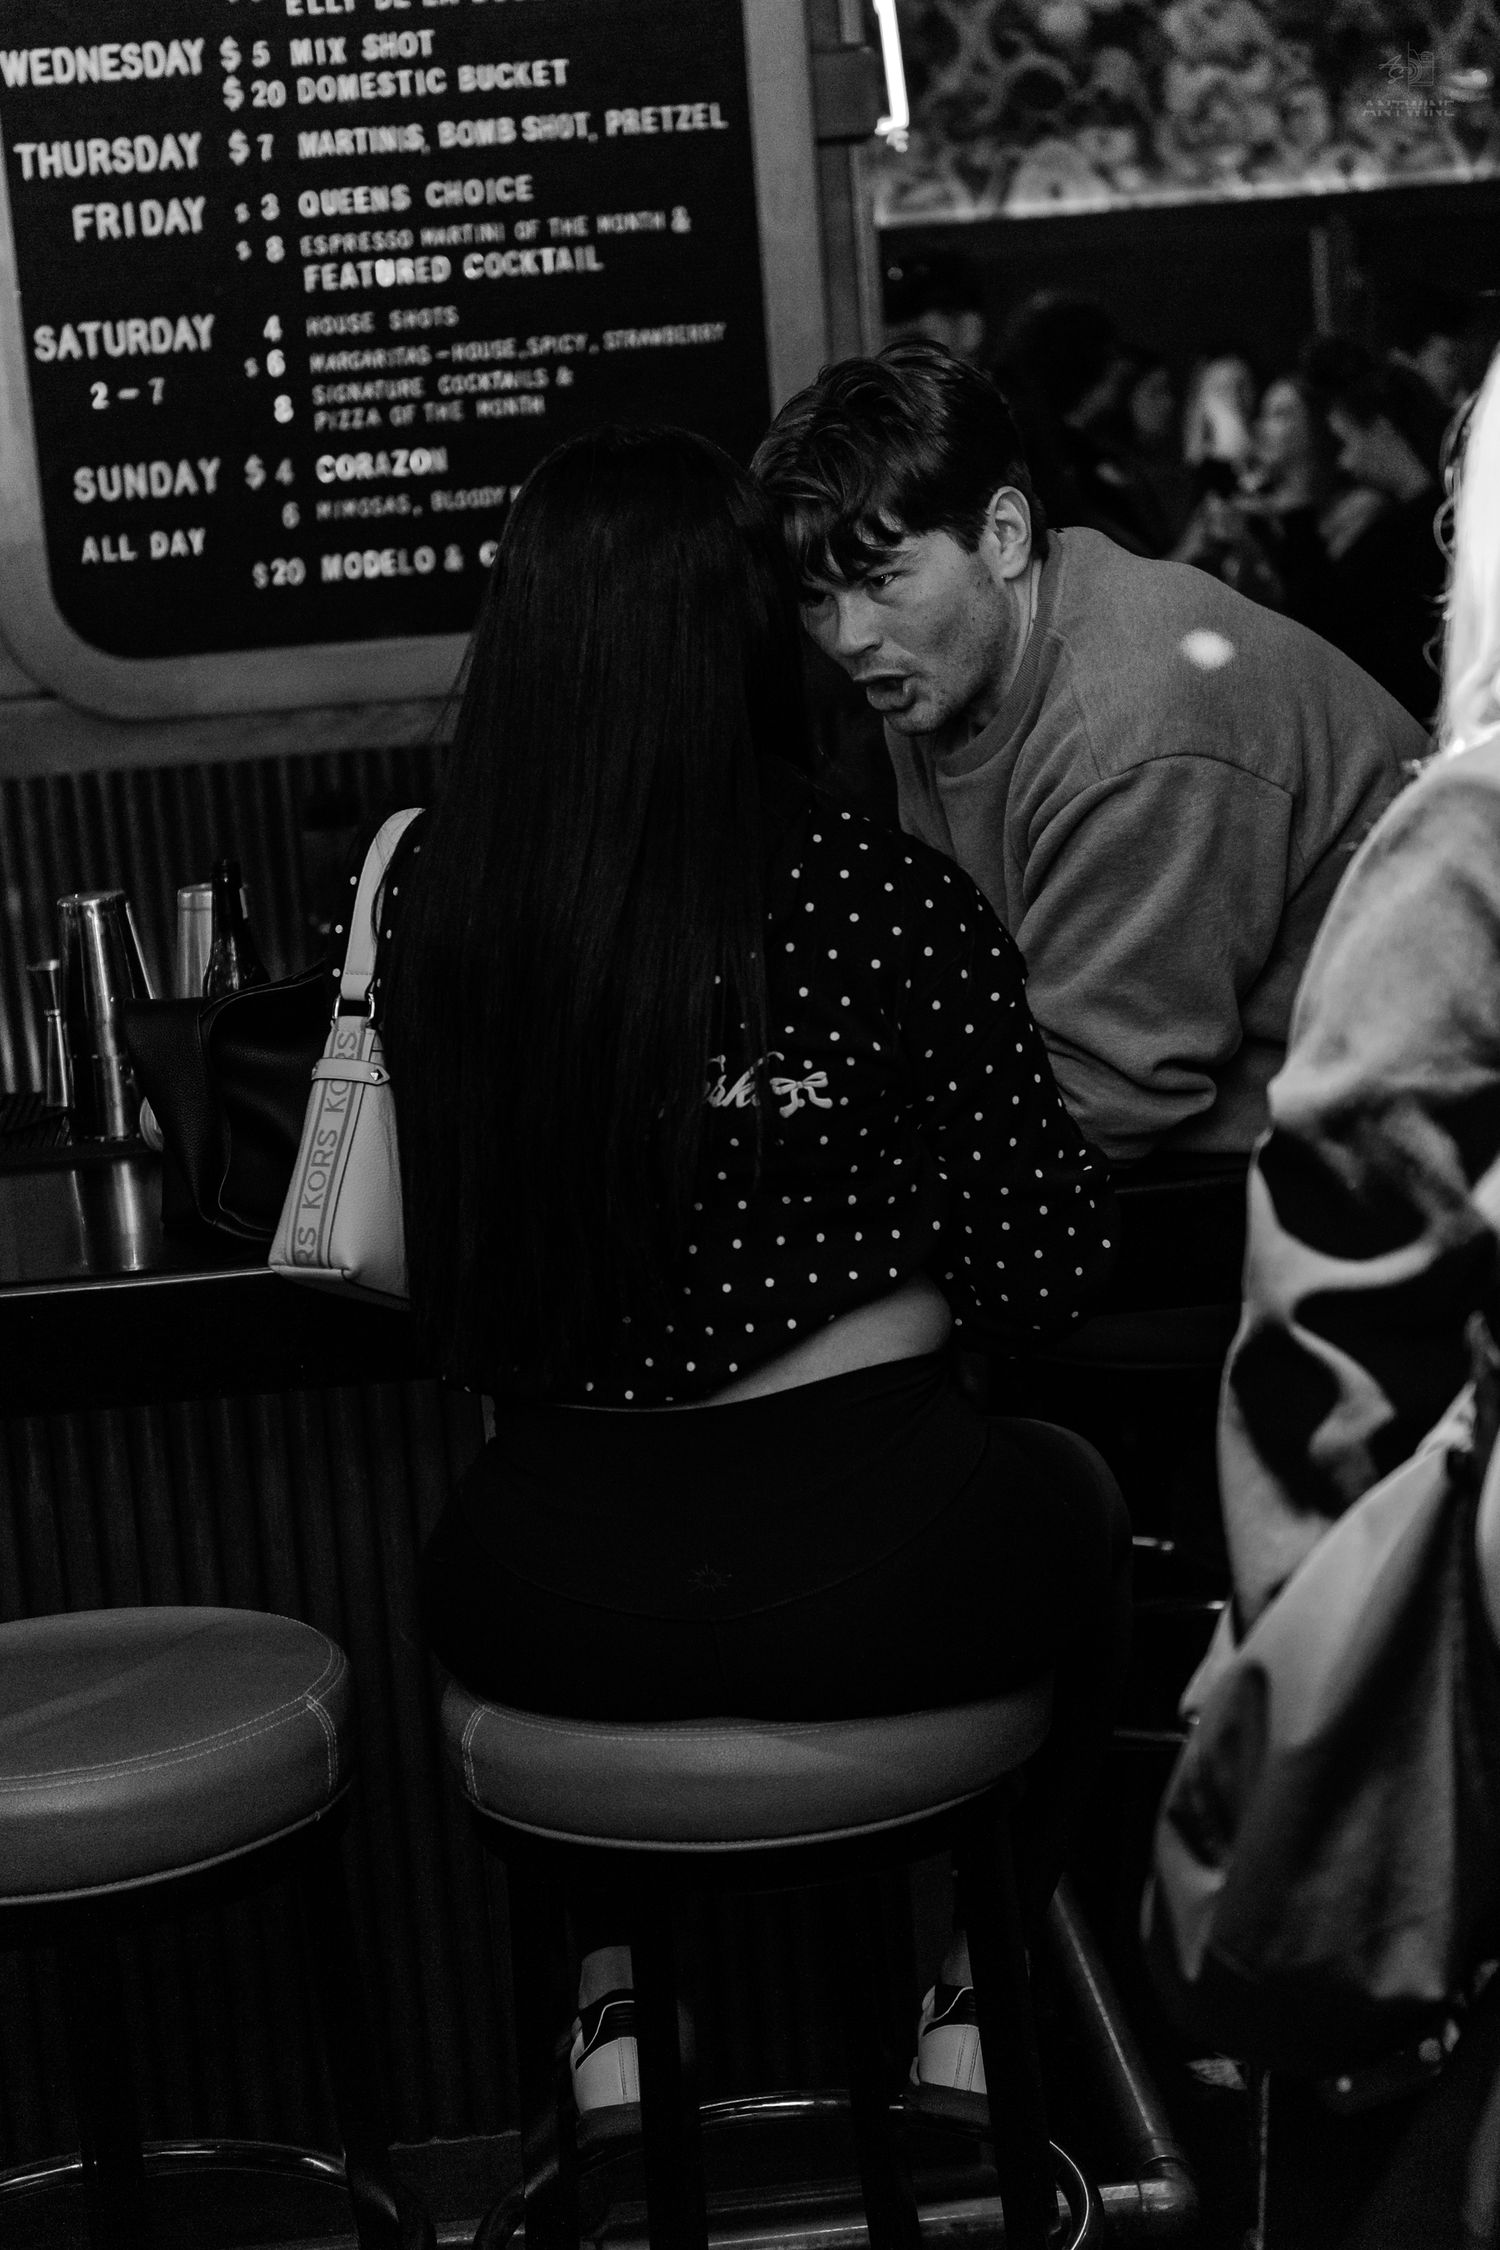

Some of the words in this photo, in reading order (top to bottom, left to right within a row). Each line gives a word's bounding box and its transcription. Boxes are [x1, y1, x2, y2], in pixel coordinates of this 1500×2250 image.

[0, 37, 205, 88] WEDNESDAY
[289, 36, 347, 67] MIX
[361, 29, 435, 62] SHOT
[296, 67, 447, 105] DOMESTIC
[457, 58, 569, 93] BUCKET
[13, 131, 202, 182] THURSDAY
[437, 117, 517, 149] BOMB
[604, 102, 729, 137] PRETZEL
[72, 196, 206, 243] FRIDAY
[298, 183, 412, 218] QUEENS
[425, 174, 534, 208] CHOICE
[299, 229, 414, 257] ESPRESSO
[514, 219, 540, 240] OF
[547, 215, 589, 237] THE
[596, 211, 666, 234] MONTH
[671, 206, 691, 233] &
[303, 255, 451, 293] FEATURED
[462, 245, 604, 280] COCKTAIL
[33, 313, 215, 363] SATURDAY
[263, 314, 283, 342] 4
[306, 311, 375, 337] HOUSE
[389, 305, 459, 331] SHOTS
[603, 322, 726, 351] STRAWBERRY
[90, 381, 110, 410] 2
[148, 377, 165, 405] 7
[312, 377, 424, 406] SIGNATURE
[438, 368, 549, 395] COCKTAILS
[556, 366, 573, 386] &
[274, 394, 294, 424] 8
[314, 407, 381, 432] PIZZA
[389, 404, 415, 426] OF
[423, 400, 463, 421] THE
[476, 395, 545, 417] MONTH
[73, 457, 220, 504] SUNDAY
[315, 447, 448, 483] CORAZON
[282, 502, 300, 529] 6
[431, 486, 505, 511] BLOODY
[82, 534, 137, 564] ALL
[150, 528, 206, 560] DAY
[321, 546, 436, 582] MODELO
[444, 544, 463, 571] &
[301, 1129, 338, 1210] KORS
